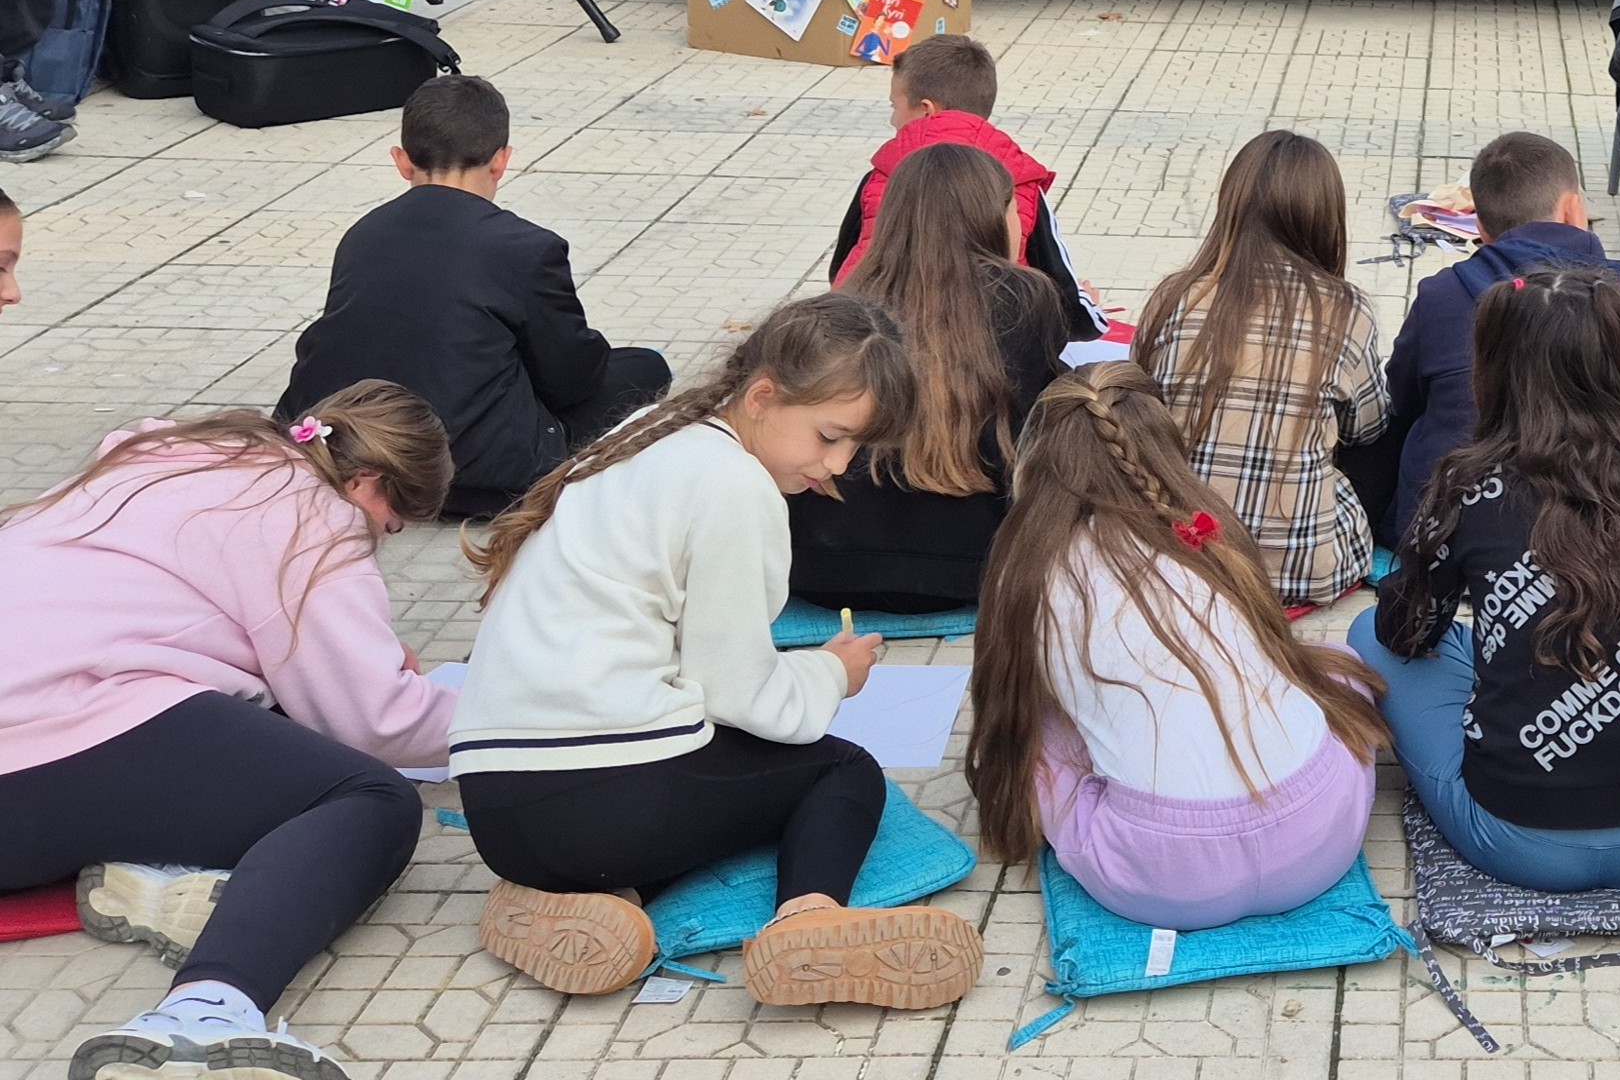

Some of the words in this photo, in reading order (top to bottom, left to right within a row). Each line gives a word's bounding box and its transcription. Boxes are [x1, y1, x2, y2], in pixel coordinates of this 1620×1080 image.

[1482, 622, 1507, 664] des
[1519, 660, 1619, 749] COMME
[1493, 898, 1560, 907] Holiday
[1483, 916, 1539, 926] Holiday
[1545, 915, 1568, 924] Time
